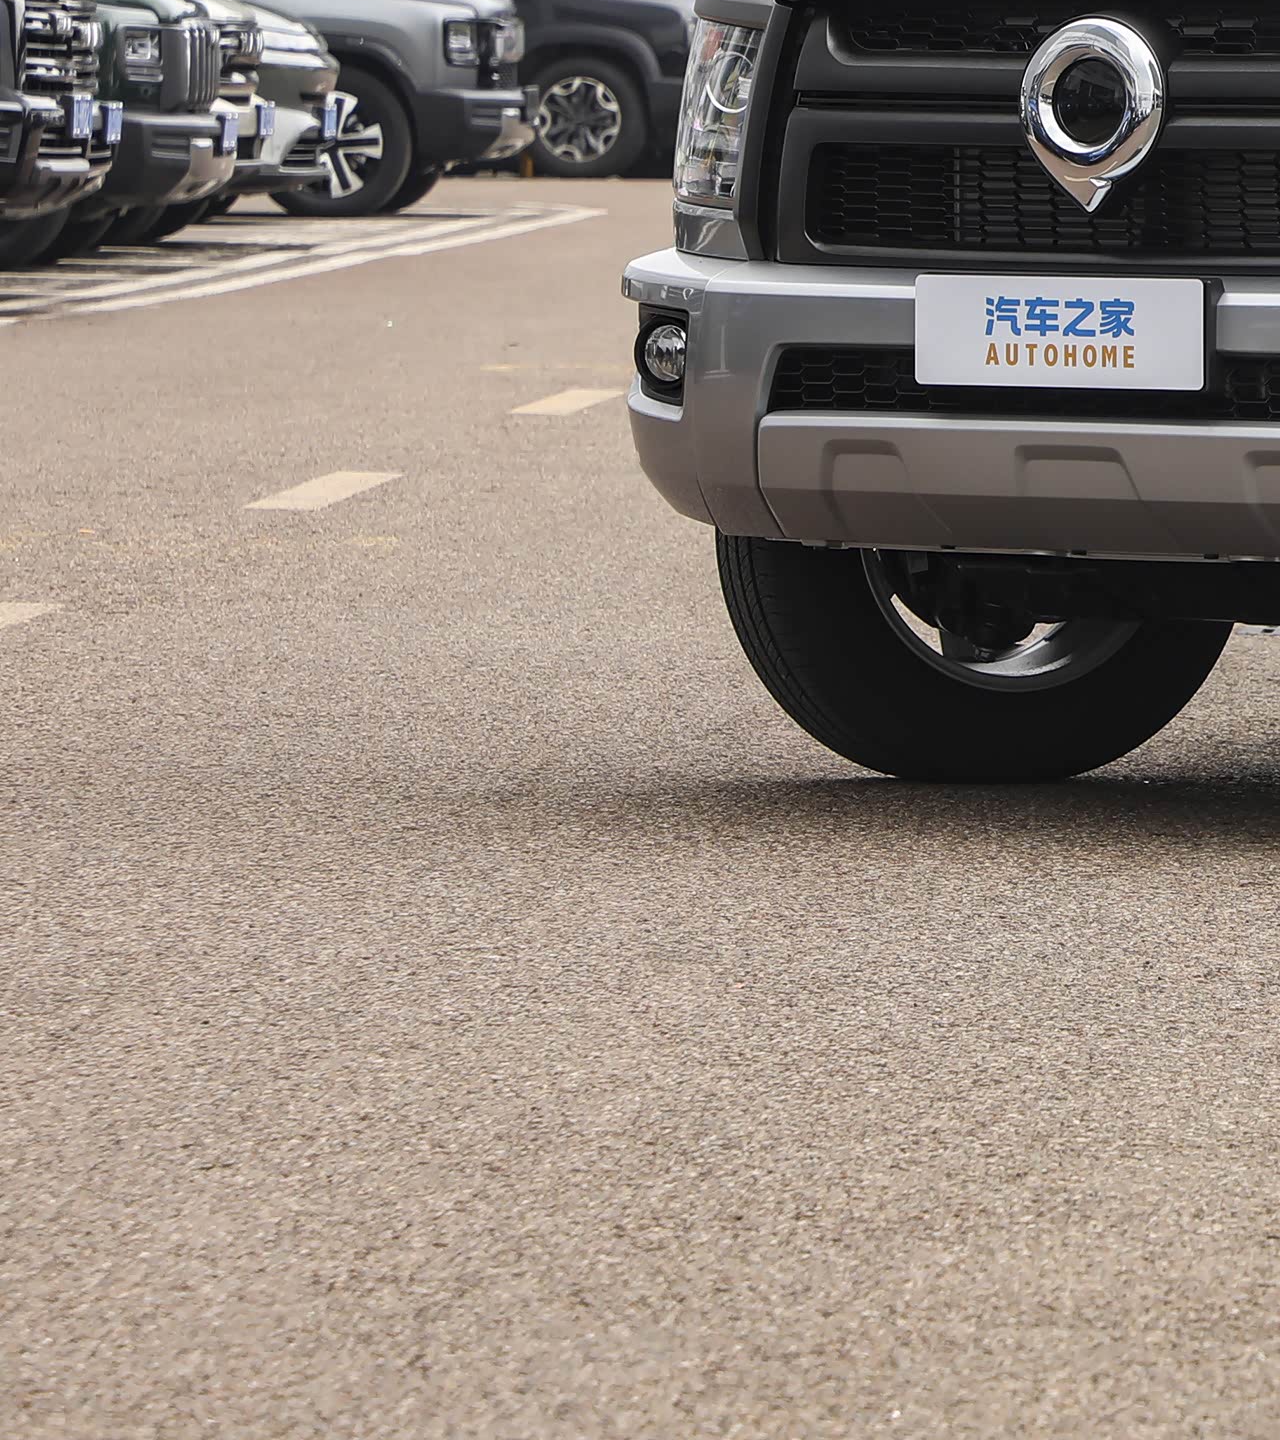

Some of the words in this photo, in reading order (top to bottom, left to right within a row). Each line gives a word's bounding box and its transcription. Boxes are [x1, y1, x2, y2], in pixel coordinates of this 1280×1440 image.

[985, 296, 1135, 338] 汽车之家
[985, 343, 1135, 368] AUTOHOME
